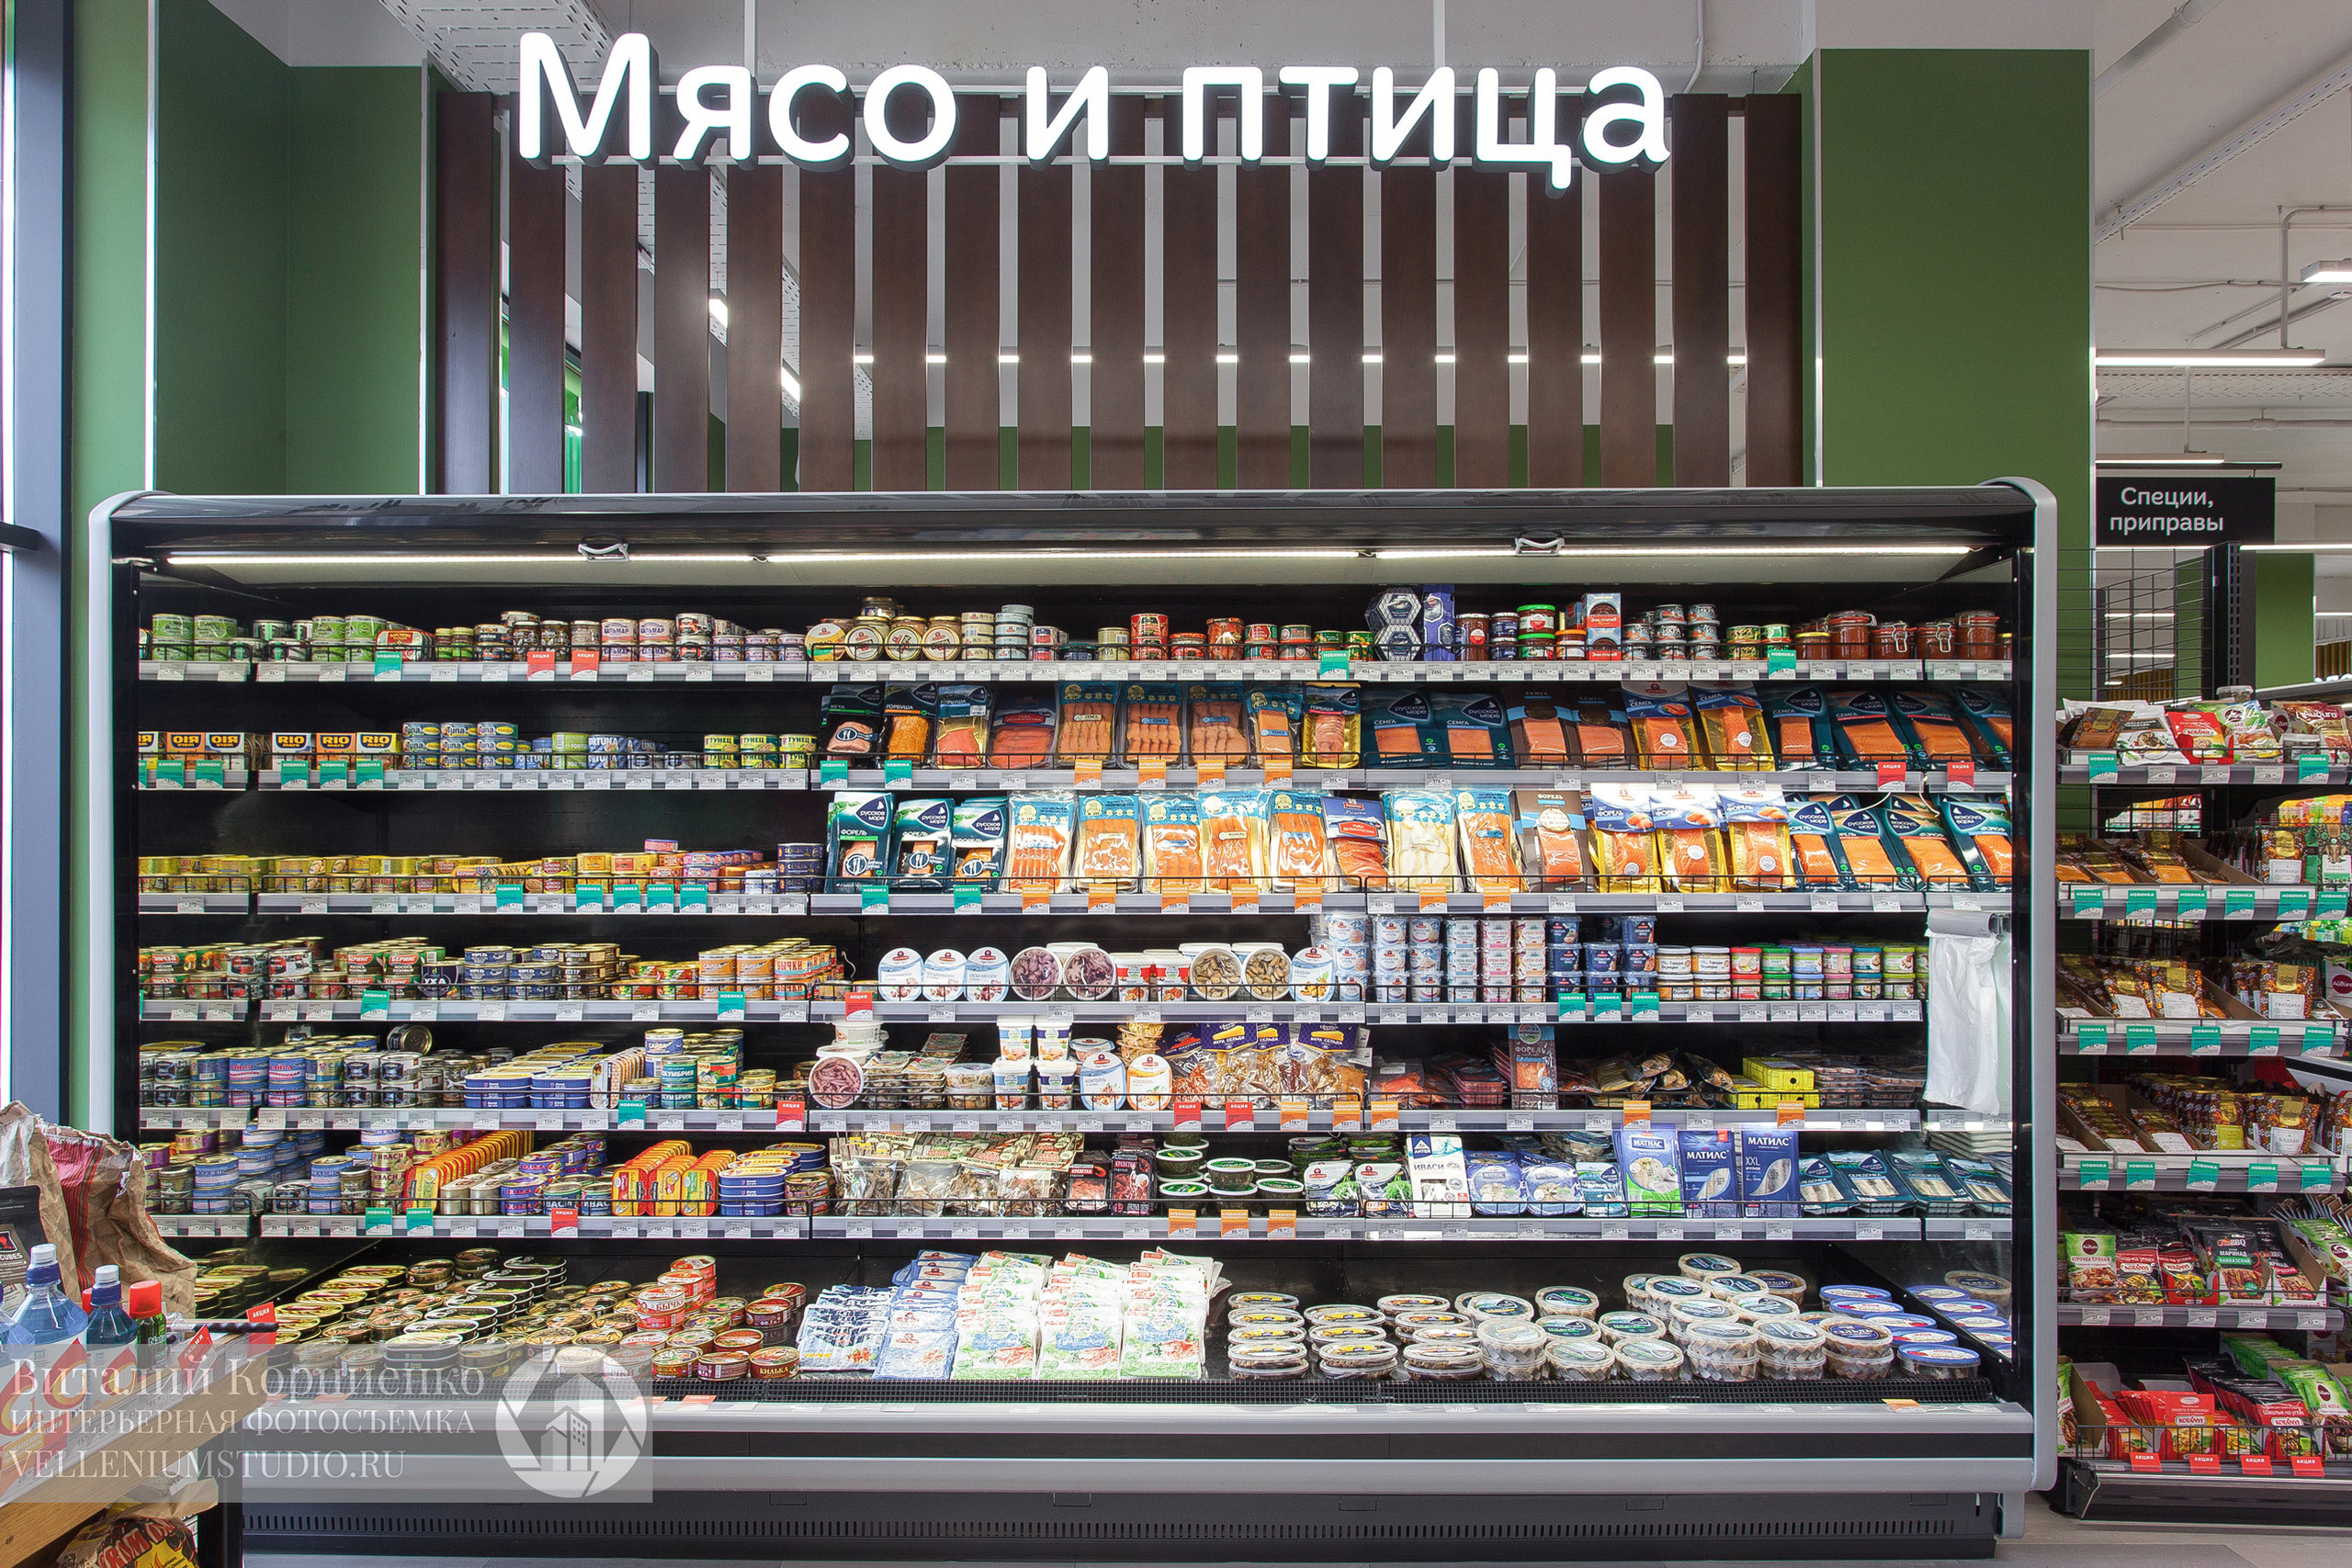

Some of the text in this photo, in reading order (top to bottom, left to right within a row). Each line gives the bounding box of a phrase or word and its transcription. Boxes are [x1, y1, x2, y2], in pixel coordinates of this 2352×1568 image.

[516, 32, 1673, 189] Мясо и птица
[2120, 487, 2213, 508] Специи,
[2109, 516, 2223, 536] приправы
[277, 735, 304, 743] RIO
[322, 735, 348, 743] RIO
[362, 735, 389, 743] RIO
[860, 810, 885, 819] русское
[922, 814, 946, 823] русское
[777, 960, 803, 970] БЫЧКИ
[1634, 1139, 1663, 1147] МАТИАС
[383, 1152, 405, 1160] ИВАСИ
[1746, 1156, 1760, 1166] XXL
[1413, 1163, 1444, 1171] ИВАСИ
[253, 1308, 270, 1318] АКЦИЯ
[759, 1367, 788, 1375] КИЛЬКА
[2178, 1416, 2204, 1425] KOTÁNYI
